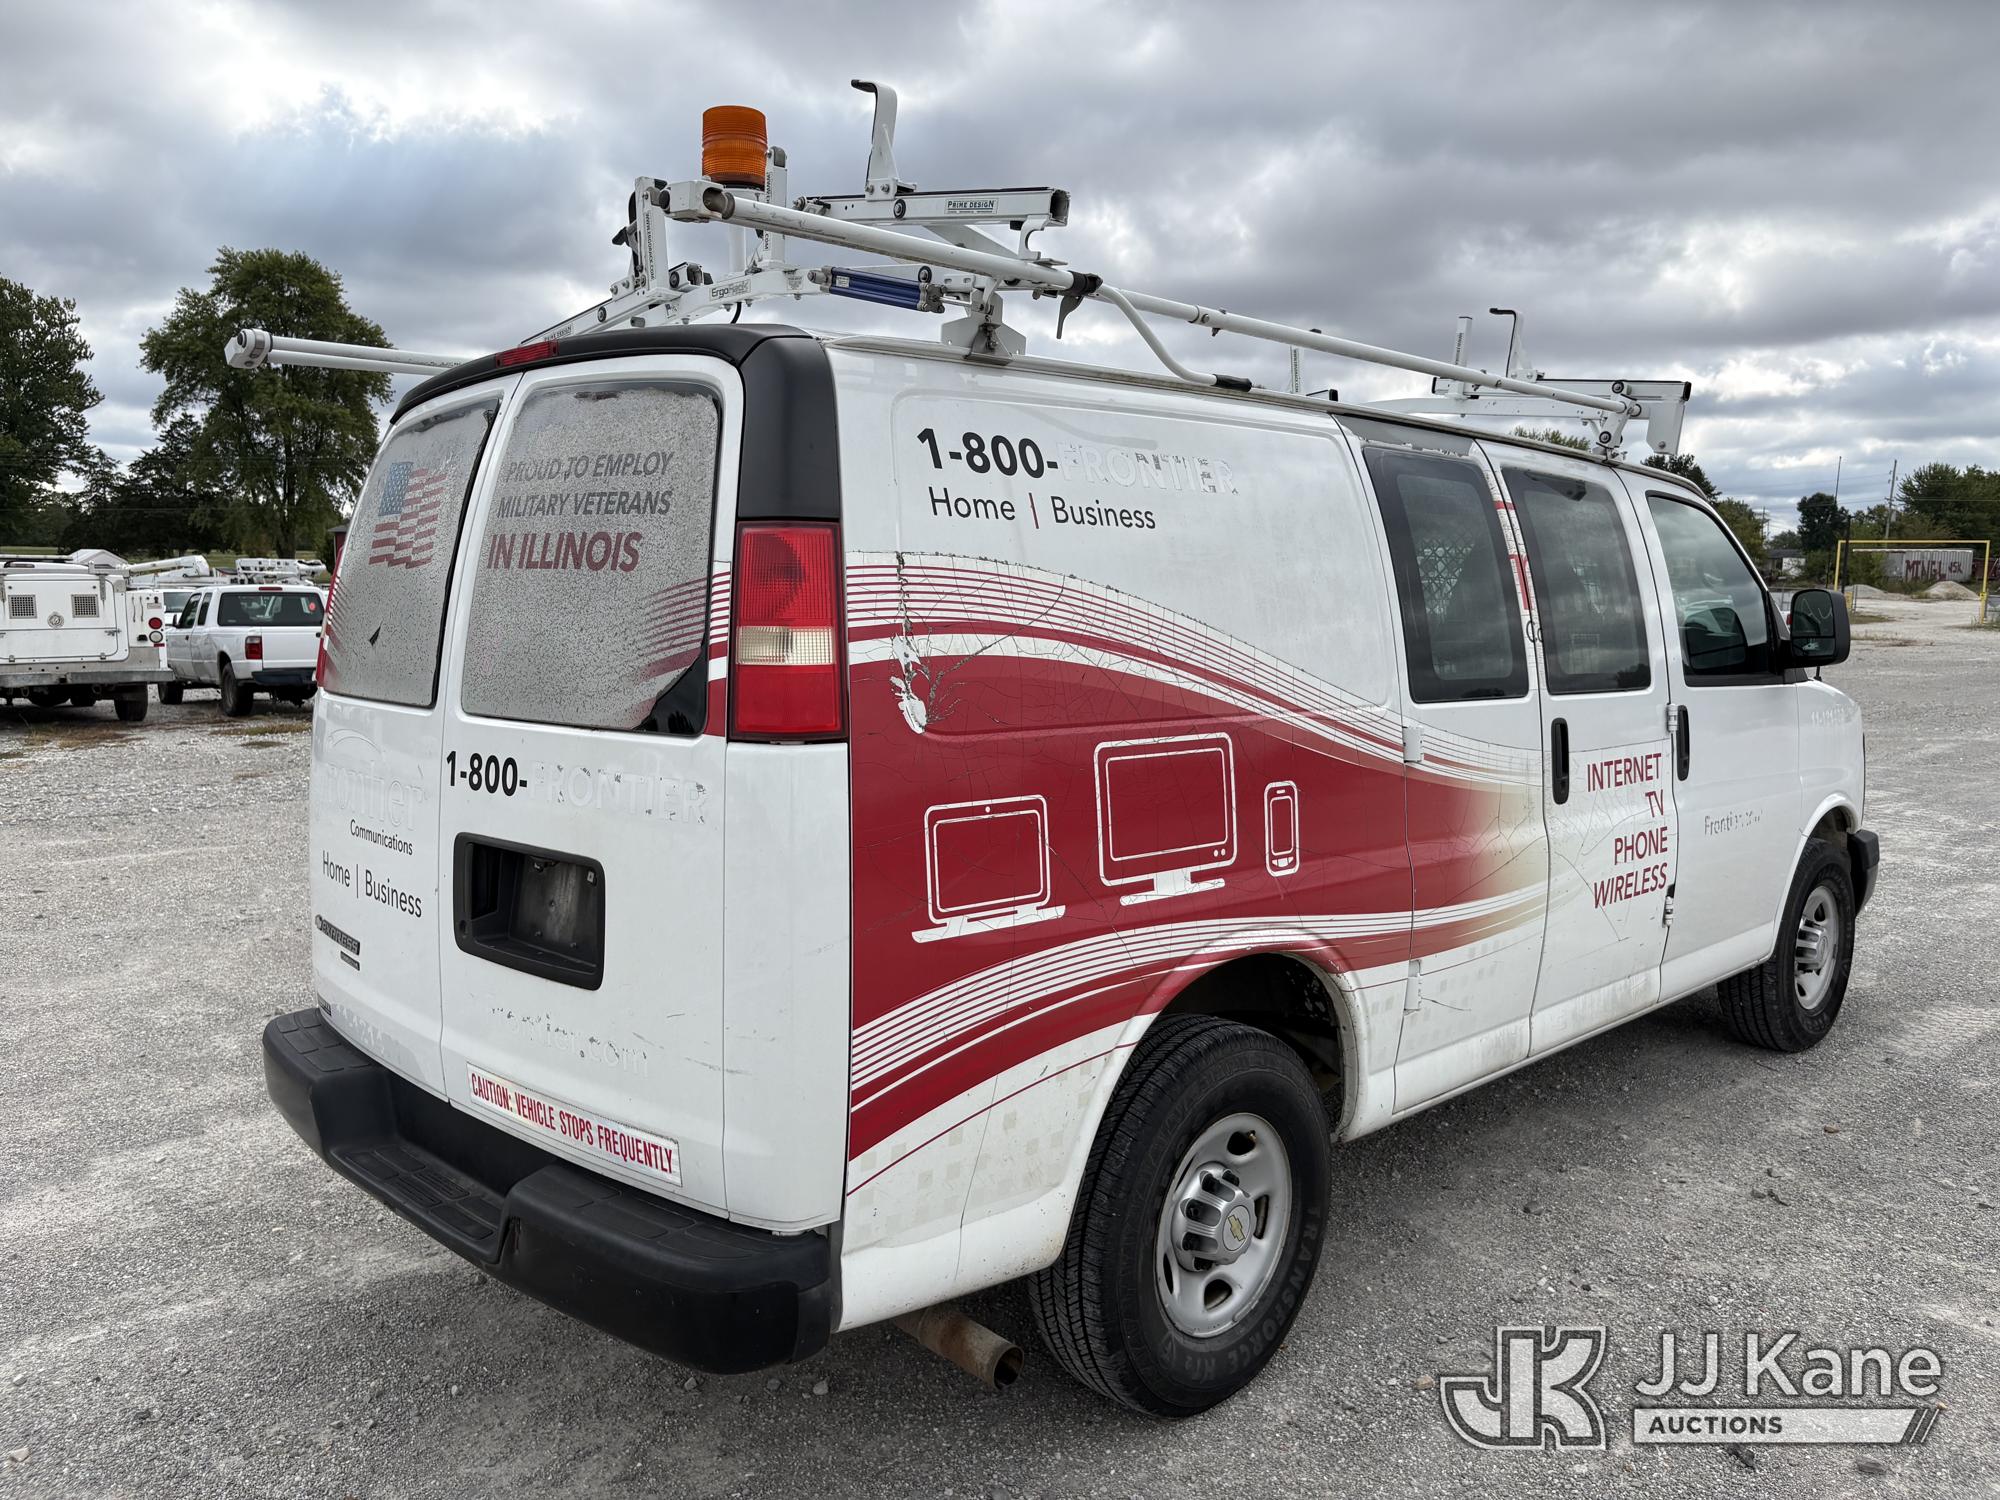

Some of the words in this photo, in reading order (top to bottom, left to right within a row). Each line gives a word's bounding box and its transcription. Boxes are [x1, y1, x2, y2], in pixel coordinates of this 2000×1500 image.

[947, 200, 967, 208] PRIME
[969, 199, 995, 208] DESIGN
[505, 457, 562, 483] PROUD
[563, 455, 590, 481] TO
[592, 451, 675, 478] EMPLOY
[497, 493, 572, 518] MILITARY
[572, 490, 674, 516] VETERANS
[928, 487, 1016, 521] Home
[1051, 495, 1156, 530] Business
[487, 533, 517, 570] IN
[518, 531, 644, 573] ILLINOIS
[1587, 752, 1662, 792] INTERNET
[1645, 789, 1665, 818] TV
[350, 818, 414, 856] Communications
[1614, 826, 1668, 866] PHONE
[322, 849, 351, 888] Home
[365, 868, 423, 918] Business
[1593, 861, 1668, 909] WIRELESS
[471, 1072, 514, 1112] CAUTION:
[514, 1091, 557, 1131] VEHICLE
[558, 1110, 594, 1146] STOPS
[597, 1124, 674, 1174] FREQUENTLY
